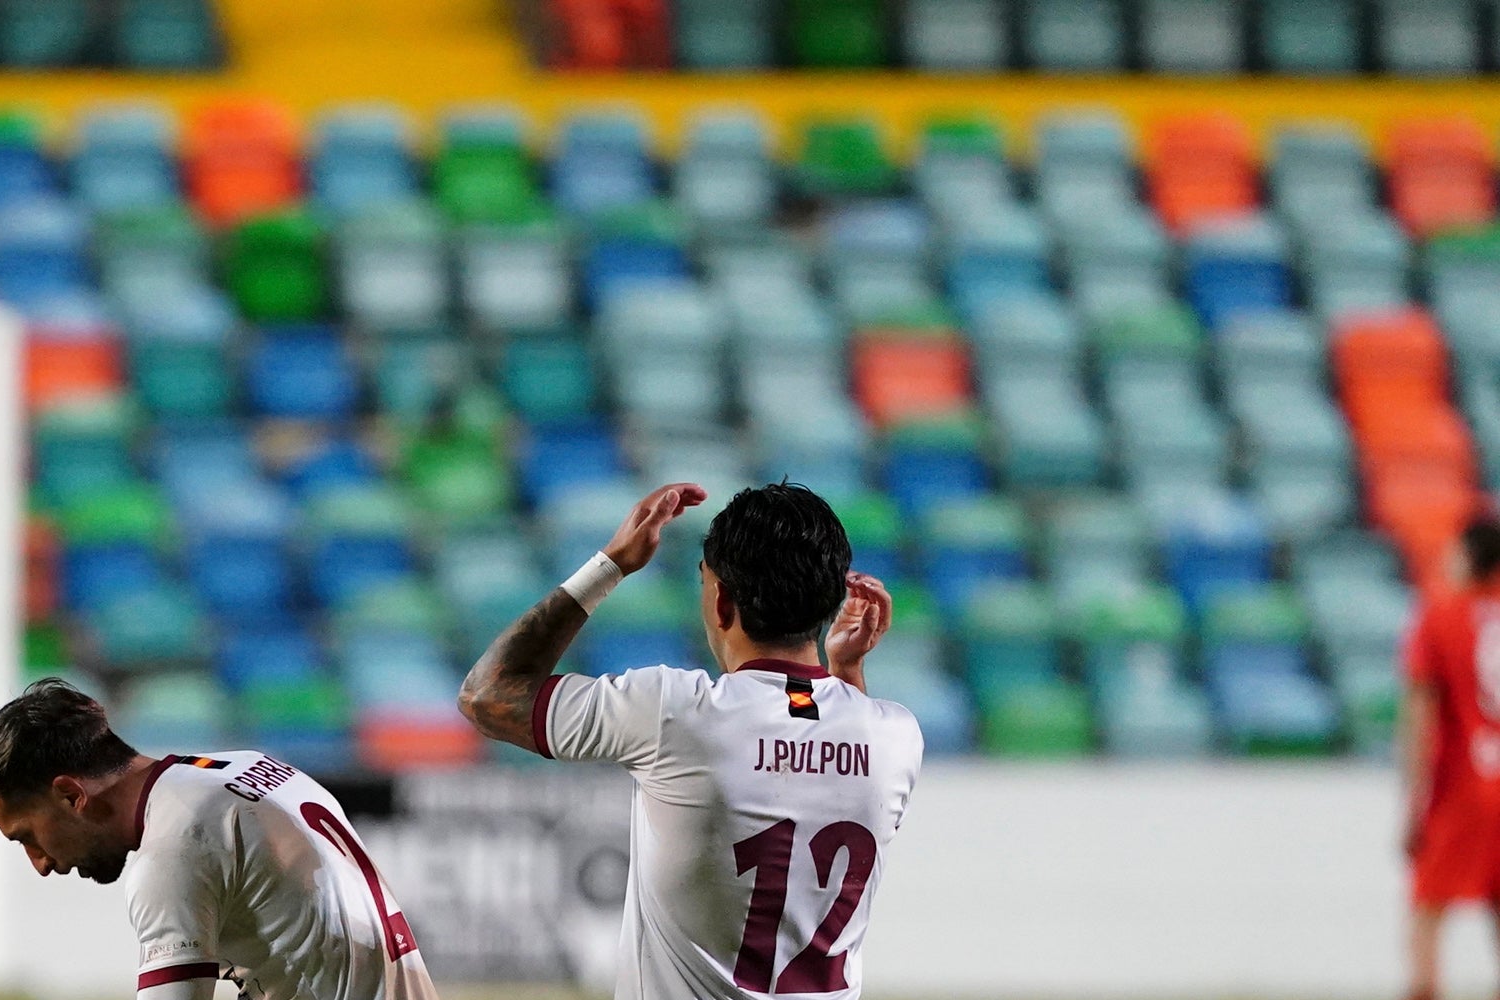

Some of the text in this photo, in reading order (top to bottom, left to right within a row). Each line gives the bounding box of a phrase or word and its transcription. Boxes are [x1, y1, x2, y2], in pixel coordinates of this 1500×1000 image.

[224, 755, 296, 802] C.PARRA
[754, 738, 870, 777] J.PULPON
[299, 802, 418, 963] 2
[732, 817, 878, 995] 12
